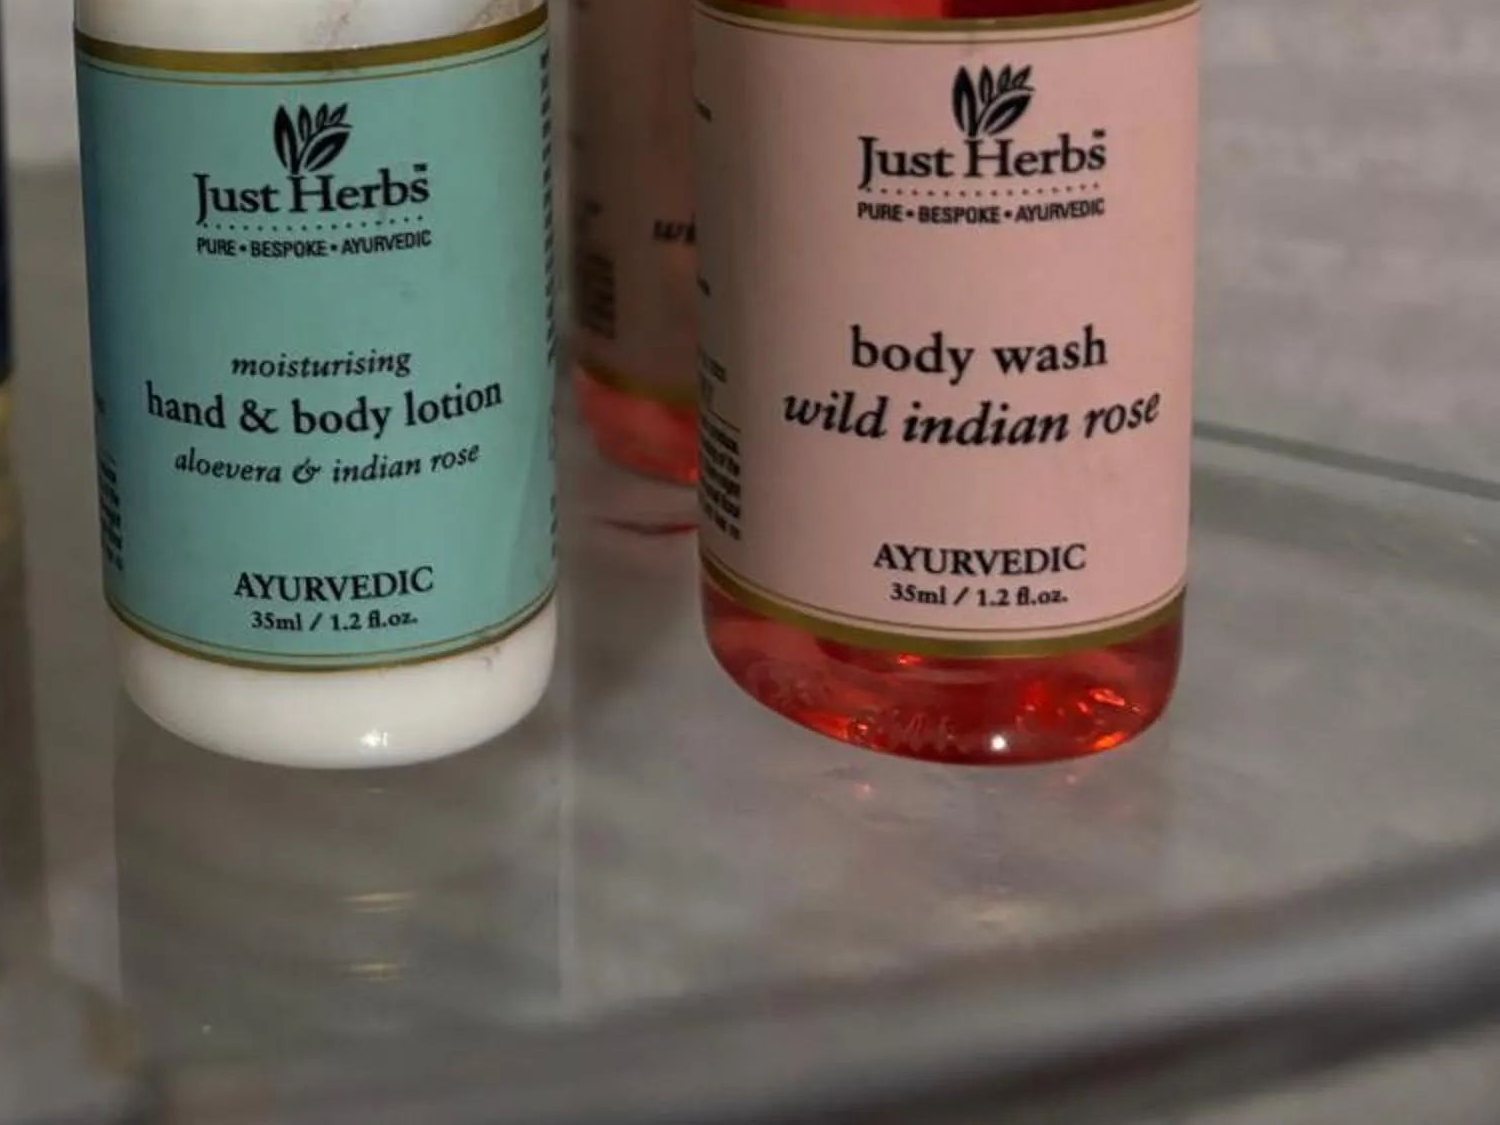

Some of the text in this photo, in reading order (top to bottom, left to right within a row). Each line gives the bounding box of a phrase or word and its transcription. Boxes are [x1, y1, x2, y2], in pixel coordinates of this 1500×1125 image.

[857, 135, 955, 190] Just
[192, 172, 281, 225] Just
[857, 197, 1105, 224] PURE BESPOKE AYURVEDIC
[196, 229, 433, 259] PURE BESPOKE AYURVEDIC
[231, 348, 411, 379] moisturising
[850, 324, 1107, 386] body wash
[144, 379, 226, 429] hand
[239, 398, 279, 435] &
[291, 395, 392, 440] body
[404, 380, 503, 427] lotion
[783, 391, 1161, 446] wild indian rose
[174, 444, 480, 485] aloevera & indian rose
[873, 542, 1086, 576] AYURVEDIC
[233, 564, 433, 602] AYURVEDIC
[890, 582, 947, 606] 35ml
[977, 588, 1011, 607] 1.2
[251, 610, 303, 632] 35ml
[330, 612, 362, 632] 1.2
